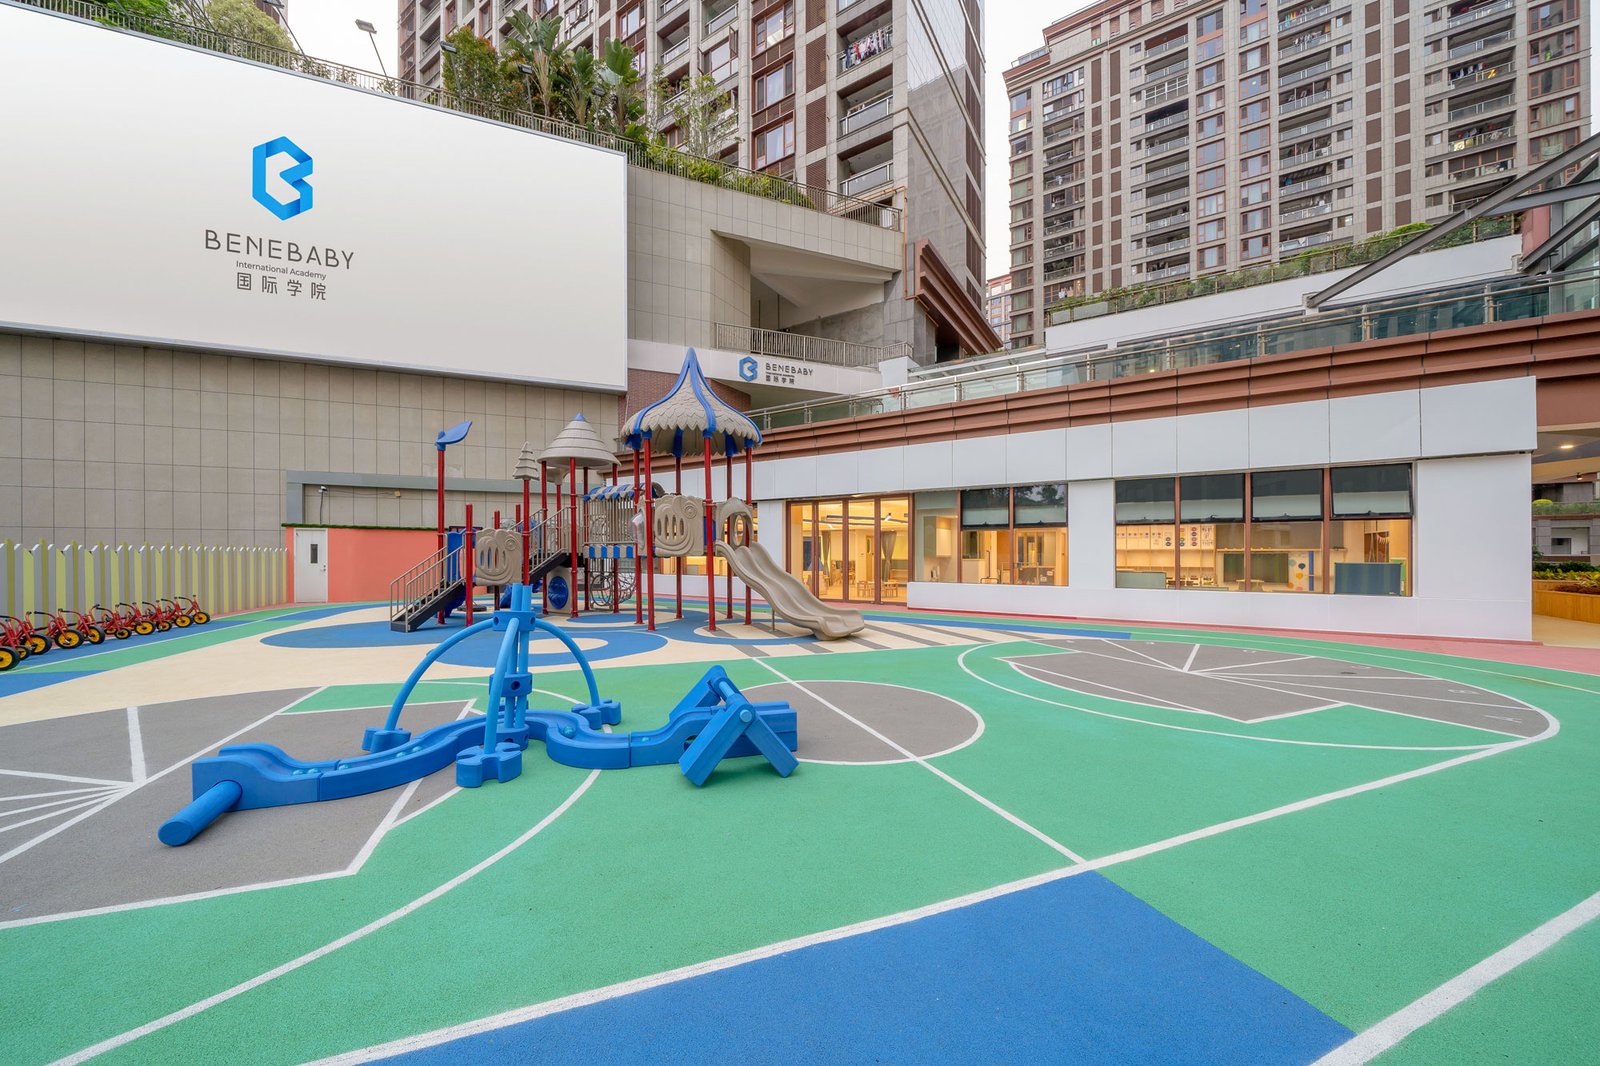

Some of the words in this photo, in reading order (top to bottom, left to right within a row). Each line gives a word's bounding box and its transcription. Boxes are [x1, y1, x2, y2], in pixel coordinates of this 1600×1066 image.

[205, 229, 354, 270] BENEBABY
[236, 260, 288, 274] International
[290, 268, 327, 281] Academy
[237, 272, 327, 300] 国际学院
[765, 362, 814, 376] BENEBABY
